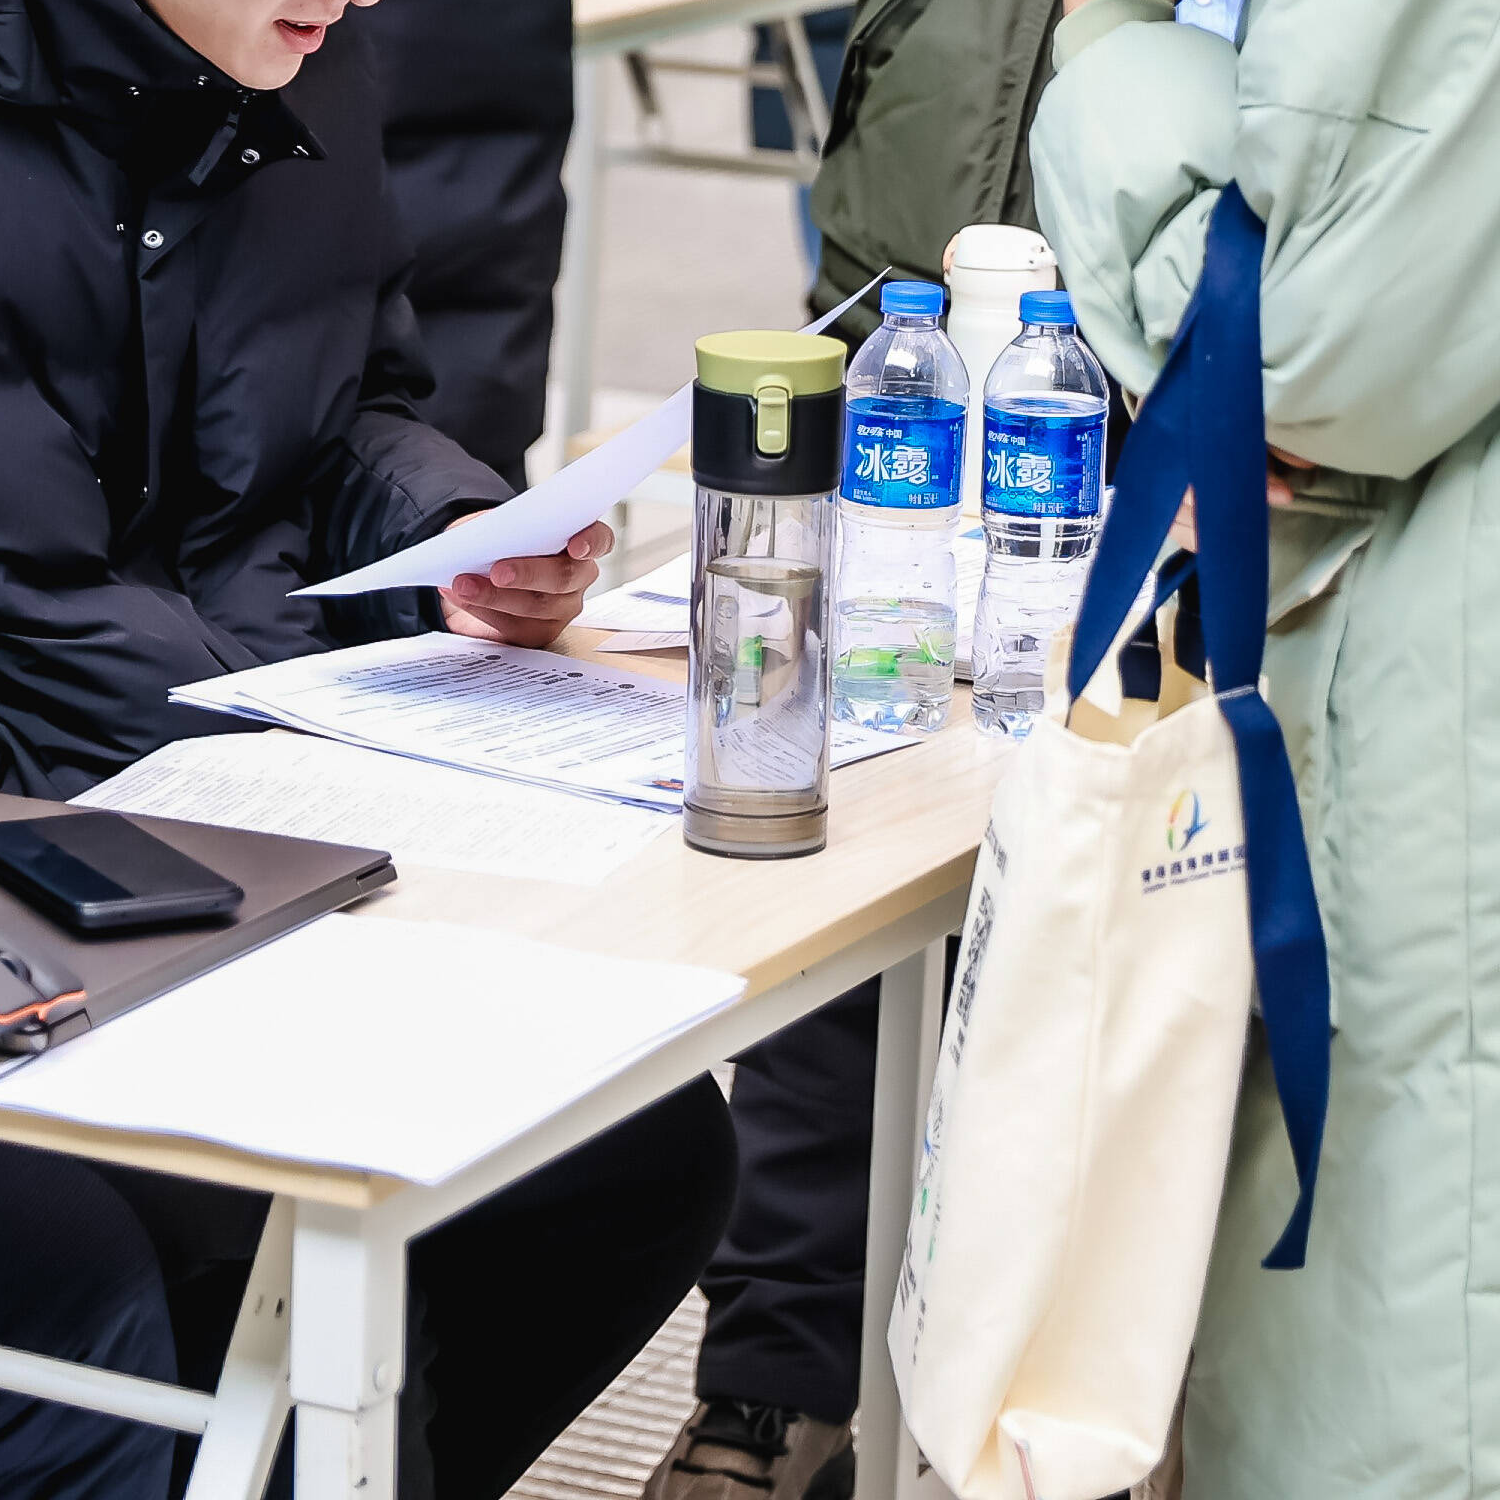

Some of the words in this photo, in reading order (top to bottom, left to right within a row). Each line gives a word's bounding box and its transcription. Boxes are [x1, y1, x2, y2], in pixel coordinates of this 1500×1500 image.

[886, 428, 903, 439] 中国
[855, 442, 931, 485] 冰露
[986, 448, 1056, 494] 冰露
